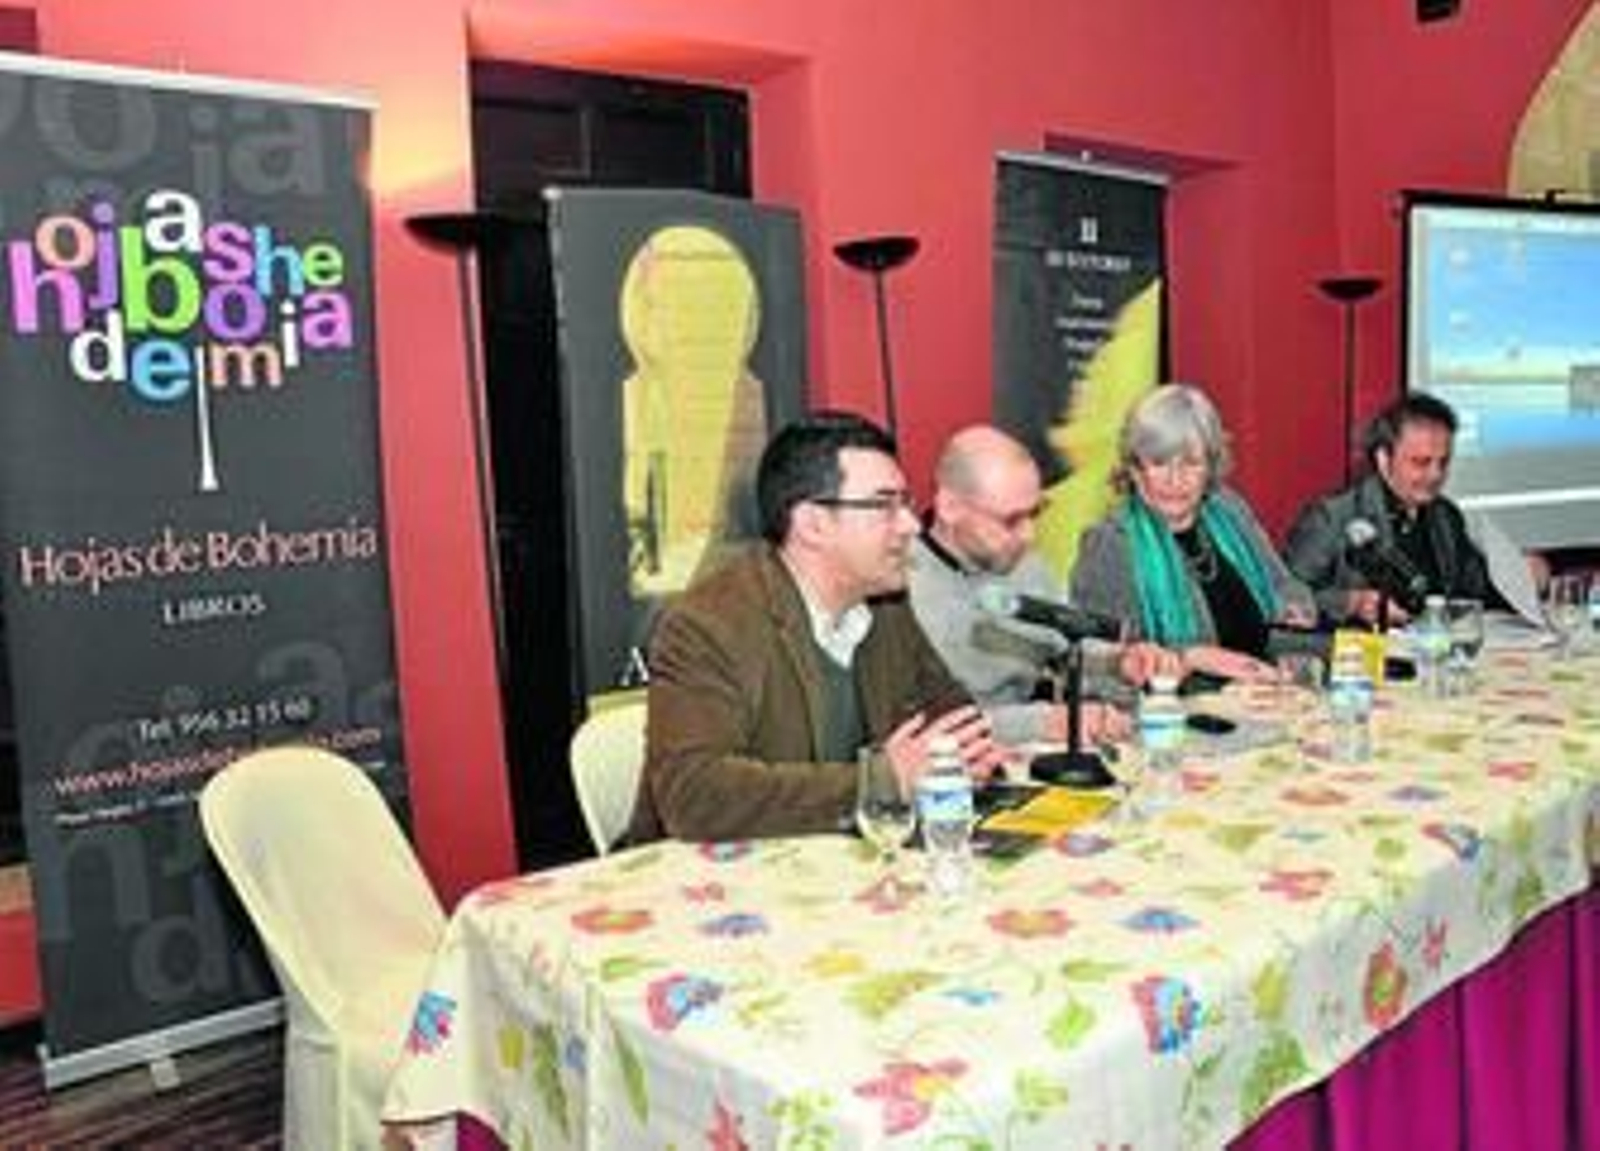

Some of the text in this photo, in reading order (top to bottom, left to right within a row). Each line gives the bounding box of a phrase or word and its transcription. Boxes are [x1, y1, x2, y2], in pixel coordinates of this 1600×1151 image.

[19, 519, 378, 596] Hojas de Bohemia
[163, 594, 266, 625] LIBROS
